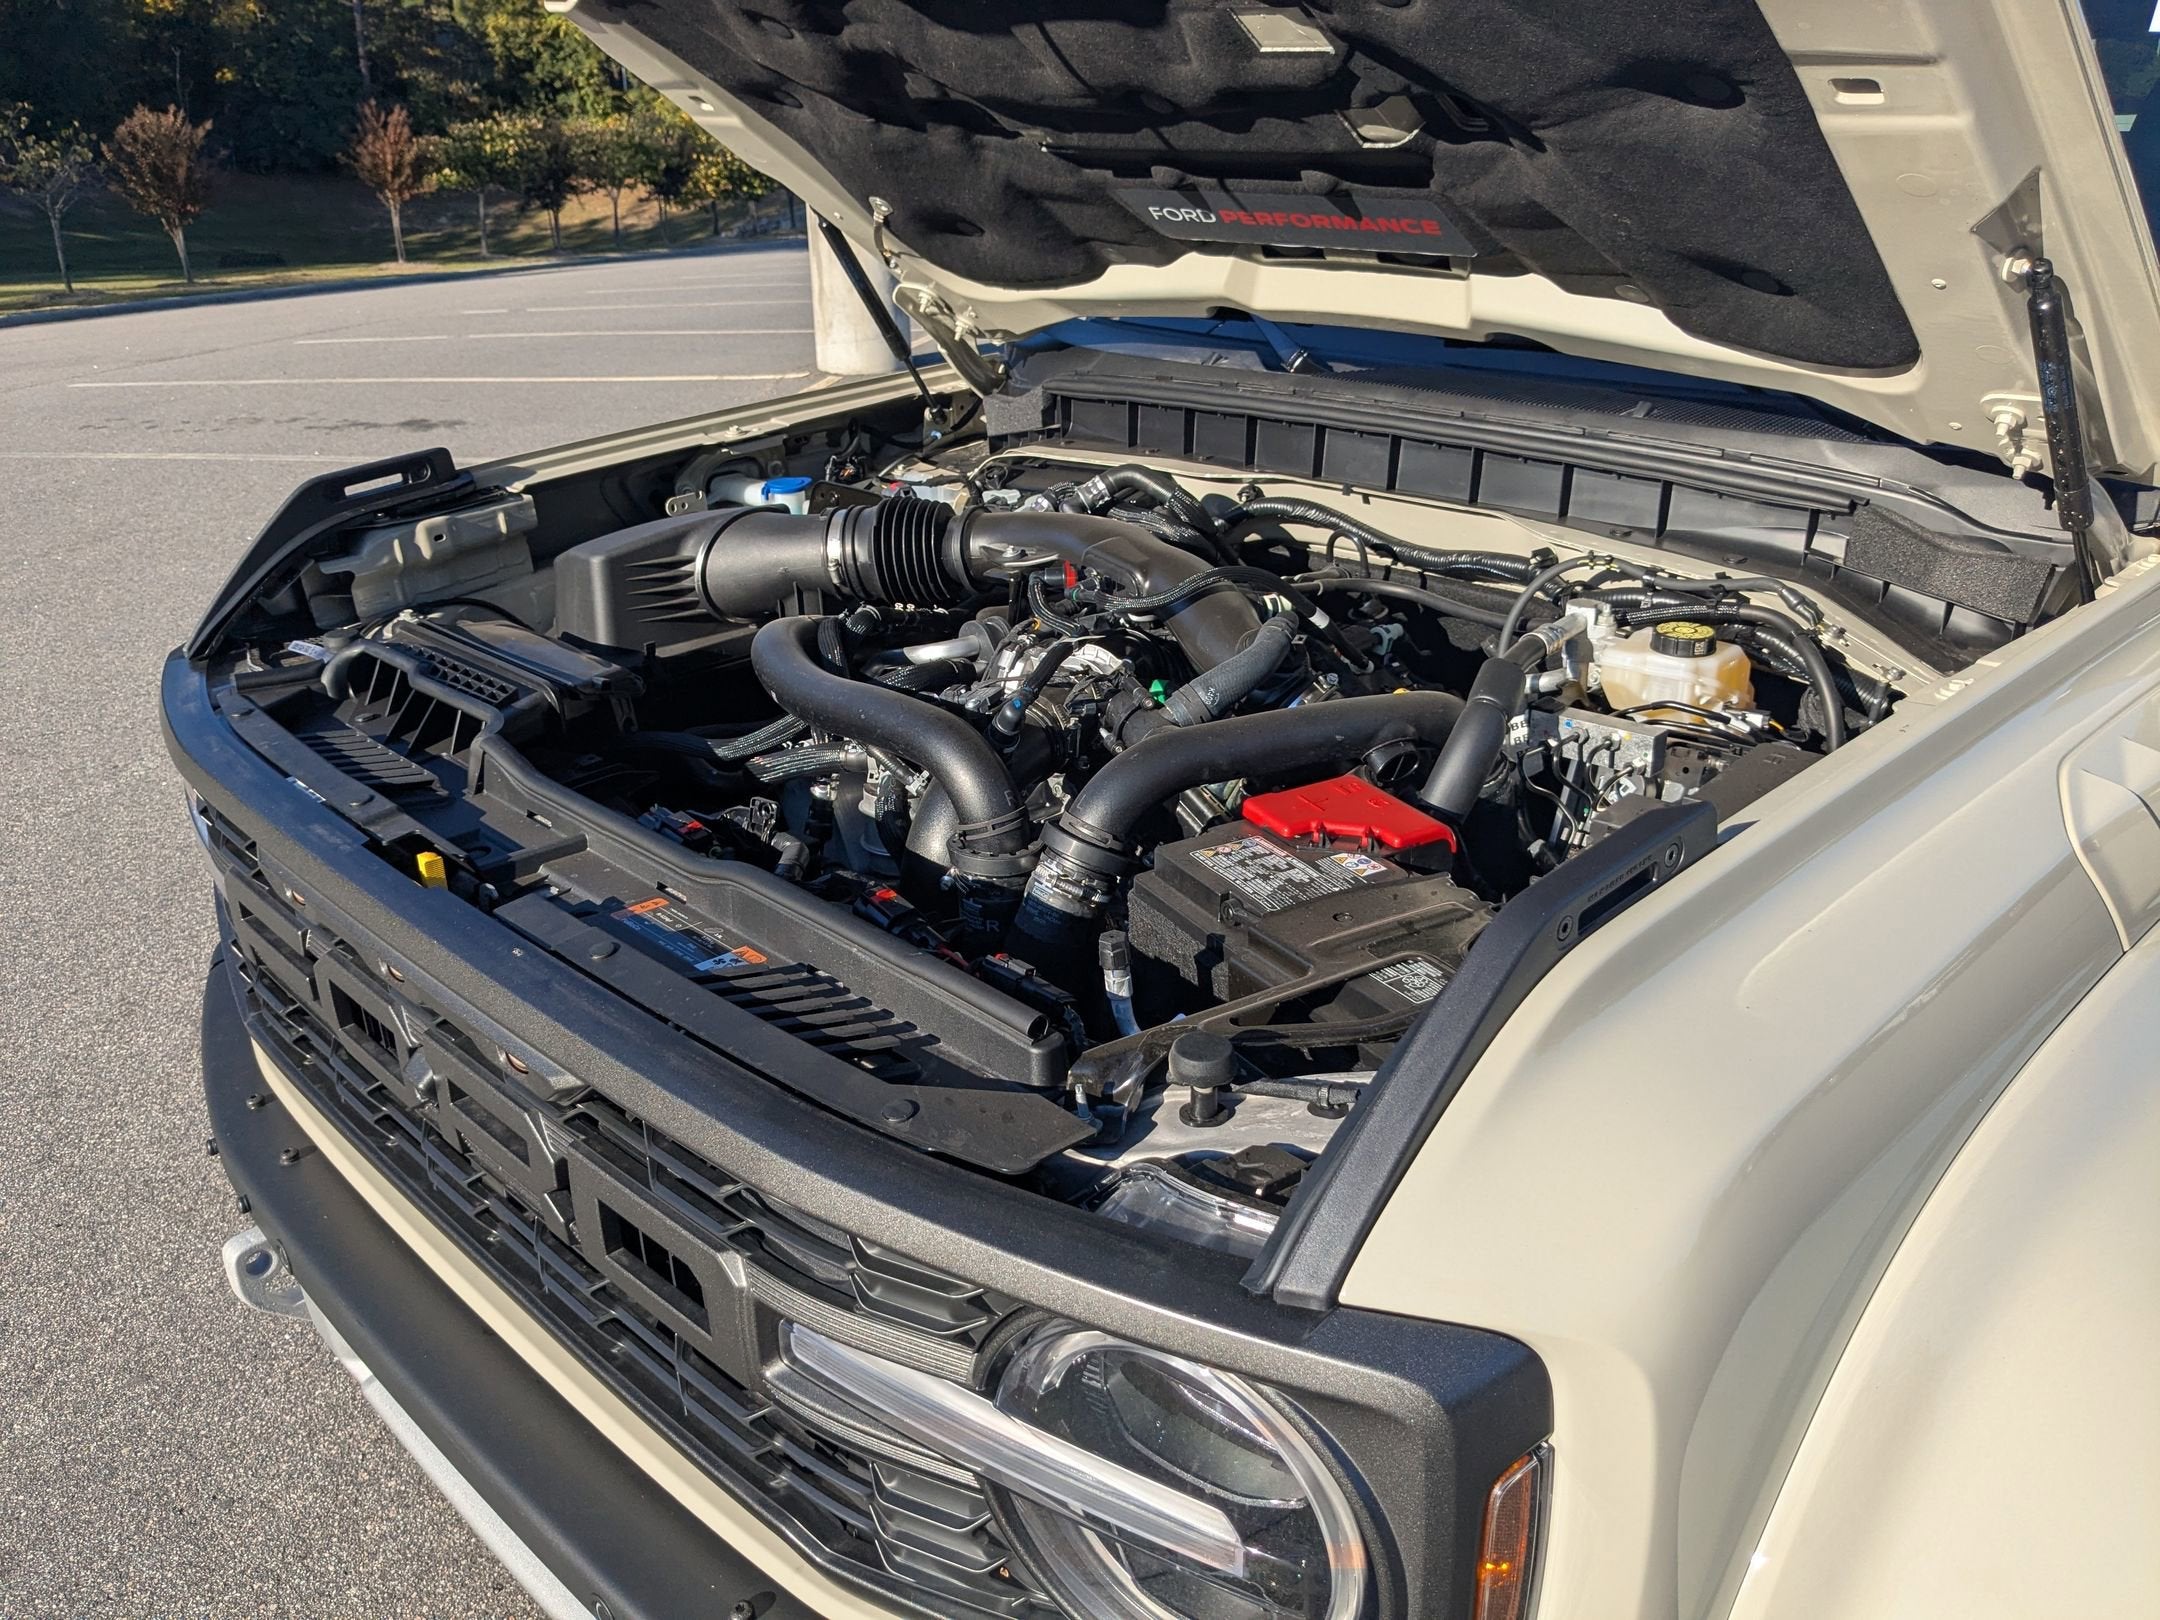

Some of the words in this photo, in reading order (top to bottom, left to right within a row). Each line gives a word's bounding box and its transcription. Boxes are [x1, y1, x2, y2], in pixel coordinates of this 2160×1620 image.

[1147, 206, 1217, 224] FORD
[1218, 208, 1442, 236] PERFORMANCE
[986, 919, 1001, 933] R
